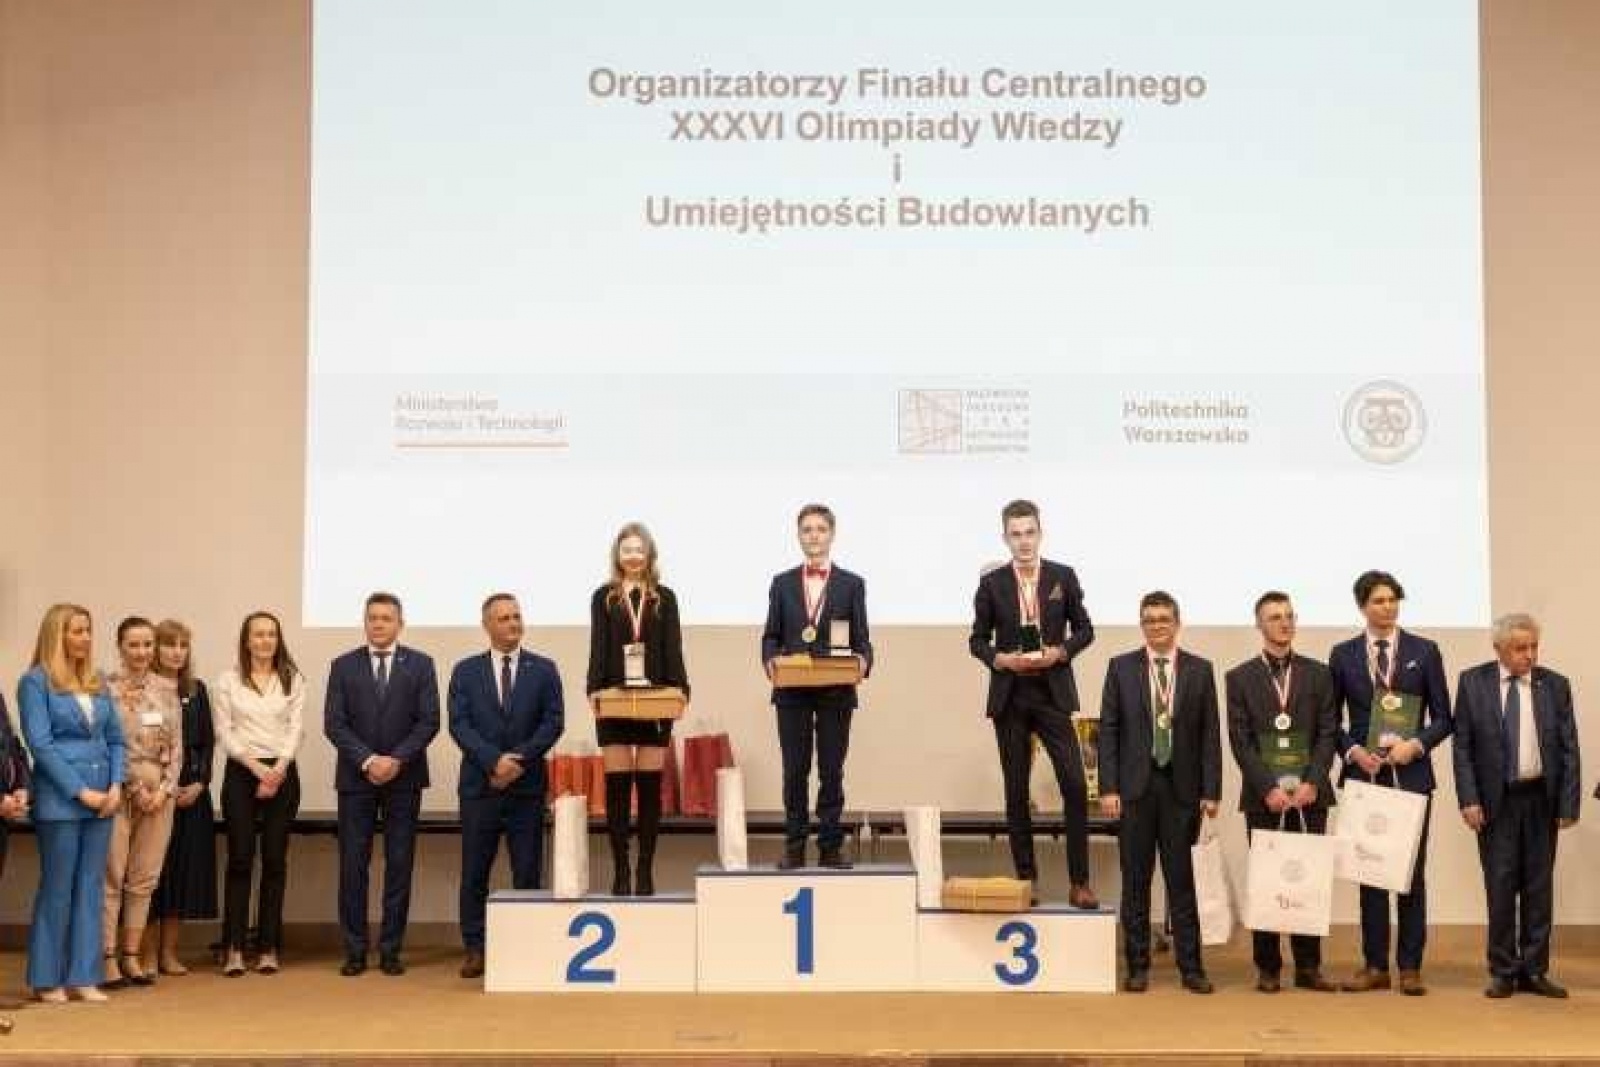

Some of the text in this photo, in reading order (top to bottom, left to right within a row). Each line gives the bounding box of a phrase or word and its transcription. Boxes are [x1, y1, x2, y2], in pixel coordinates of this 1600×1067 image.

[588, 66, 1208, 106] Organizatorzy Finału Centralnego
[669, 110, 1124, 150] XXXVI Olimpiady Wiedzy
[892, 152, 901, 183] i
[646, 195, 1150, 236] Umiejętności Budowlanych
[1122, 399, 1250, 419] Politechnika
[566, 912, 616, 984] 2
[783, 887, 814, 974] 1
[994, 921, 1040, 986] 3
